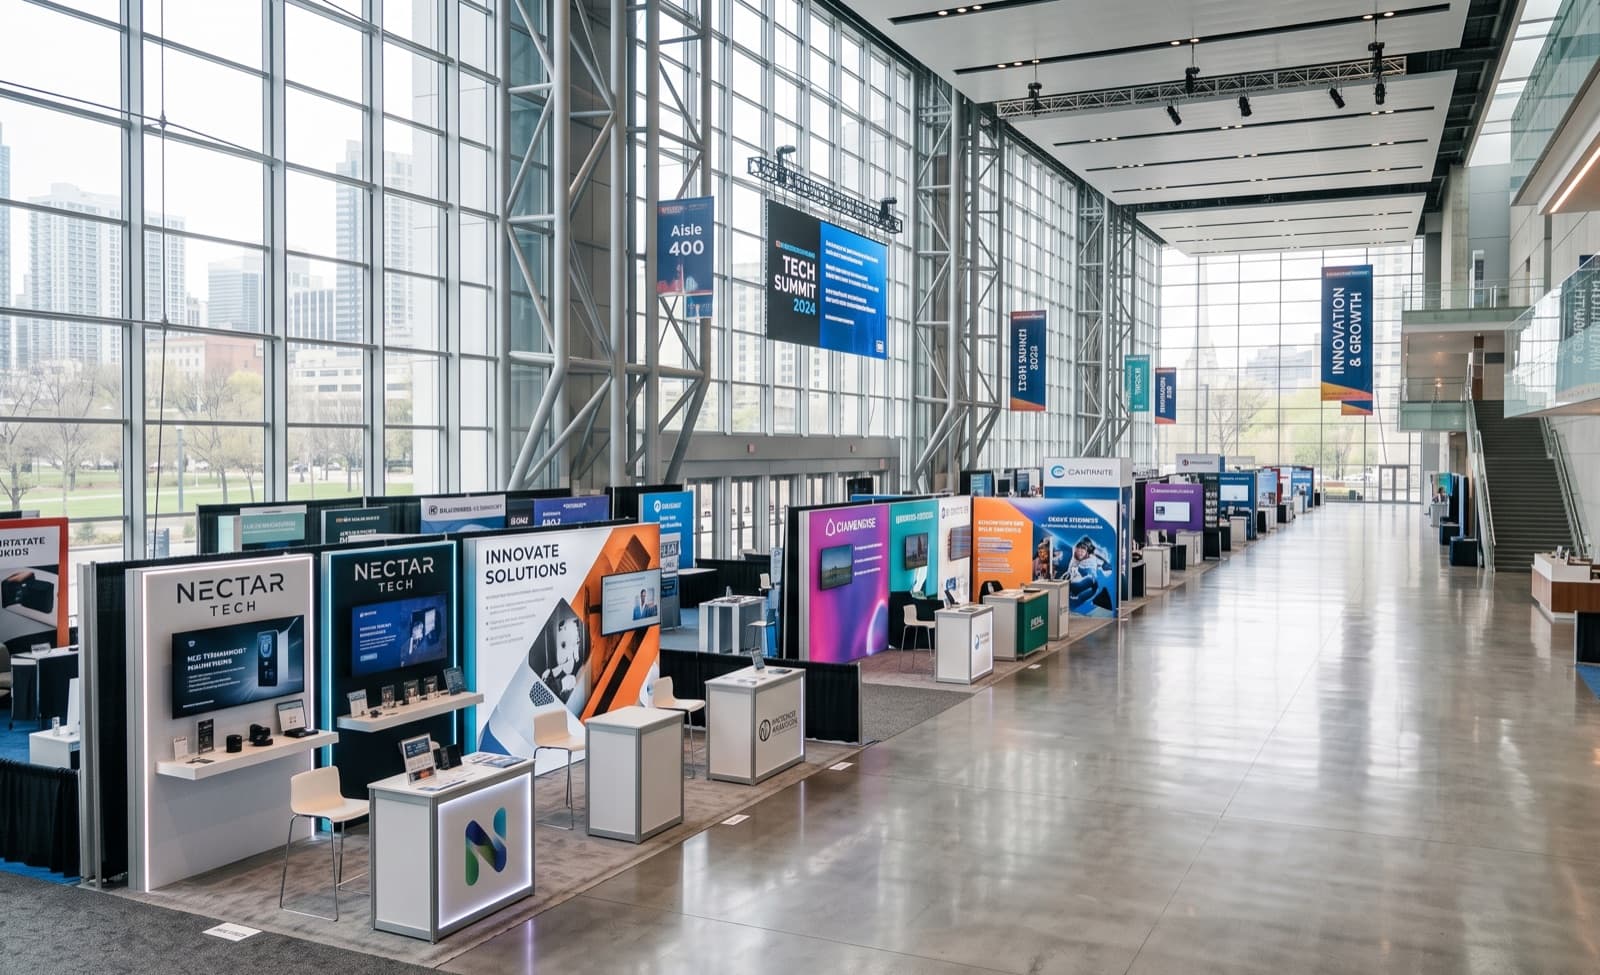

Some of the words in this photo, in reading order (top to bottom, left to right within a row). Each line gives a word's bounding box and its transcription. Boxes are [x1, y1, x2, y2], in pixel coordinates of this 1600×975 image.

[671, 223, 702, 237] Aisle
[669, 240, 704, 256] 400
[783, 255, 816, 281] TECH
[774, 274, 816, 299] SUMMIT
[793, 298, 816, 316] 2024
[1332, 287, 1345, 374] INNOVATION
[1349, 292, 1362, 354] GROWTH
[1349, 359, 1361, 367] &
[486, 544, 559, 565] INNOVATE
[354, 557, 434, 582] NECTAR
[485, 562, 567, 585] SOLUTIONS
[176, 573, 284, 604] NECTAR
[378, 579, 413, 592] TECH
[209, 600, 255, 616] TECH
